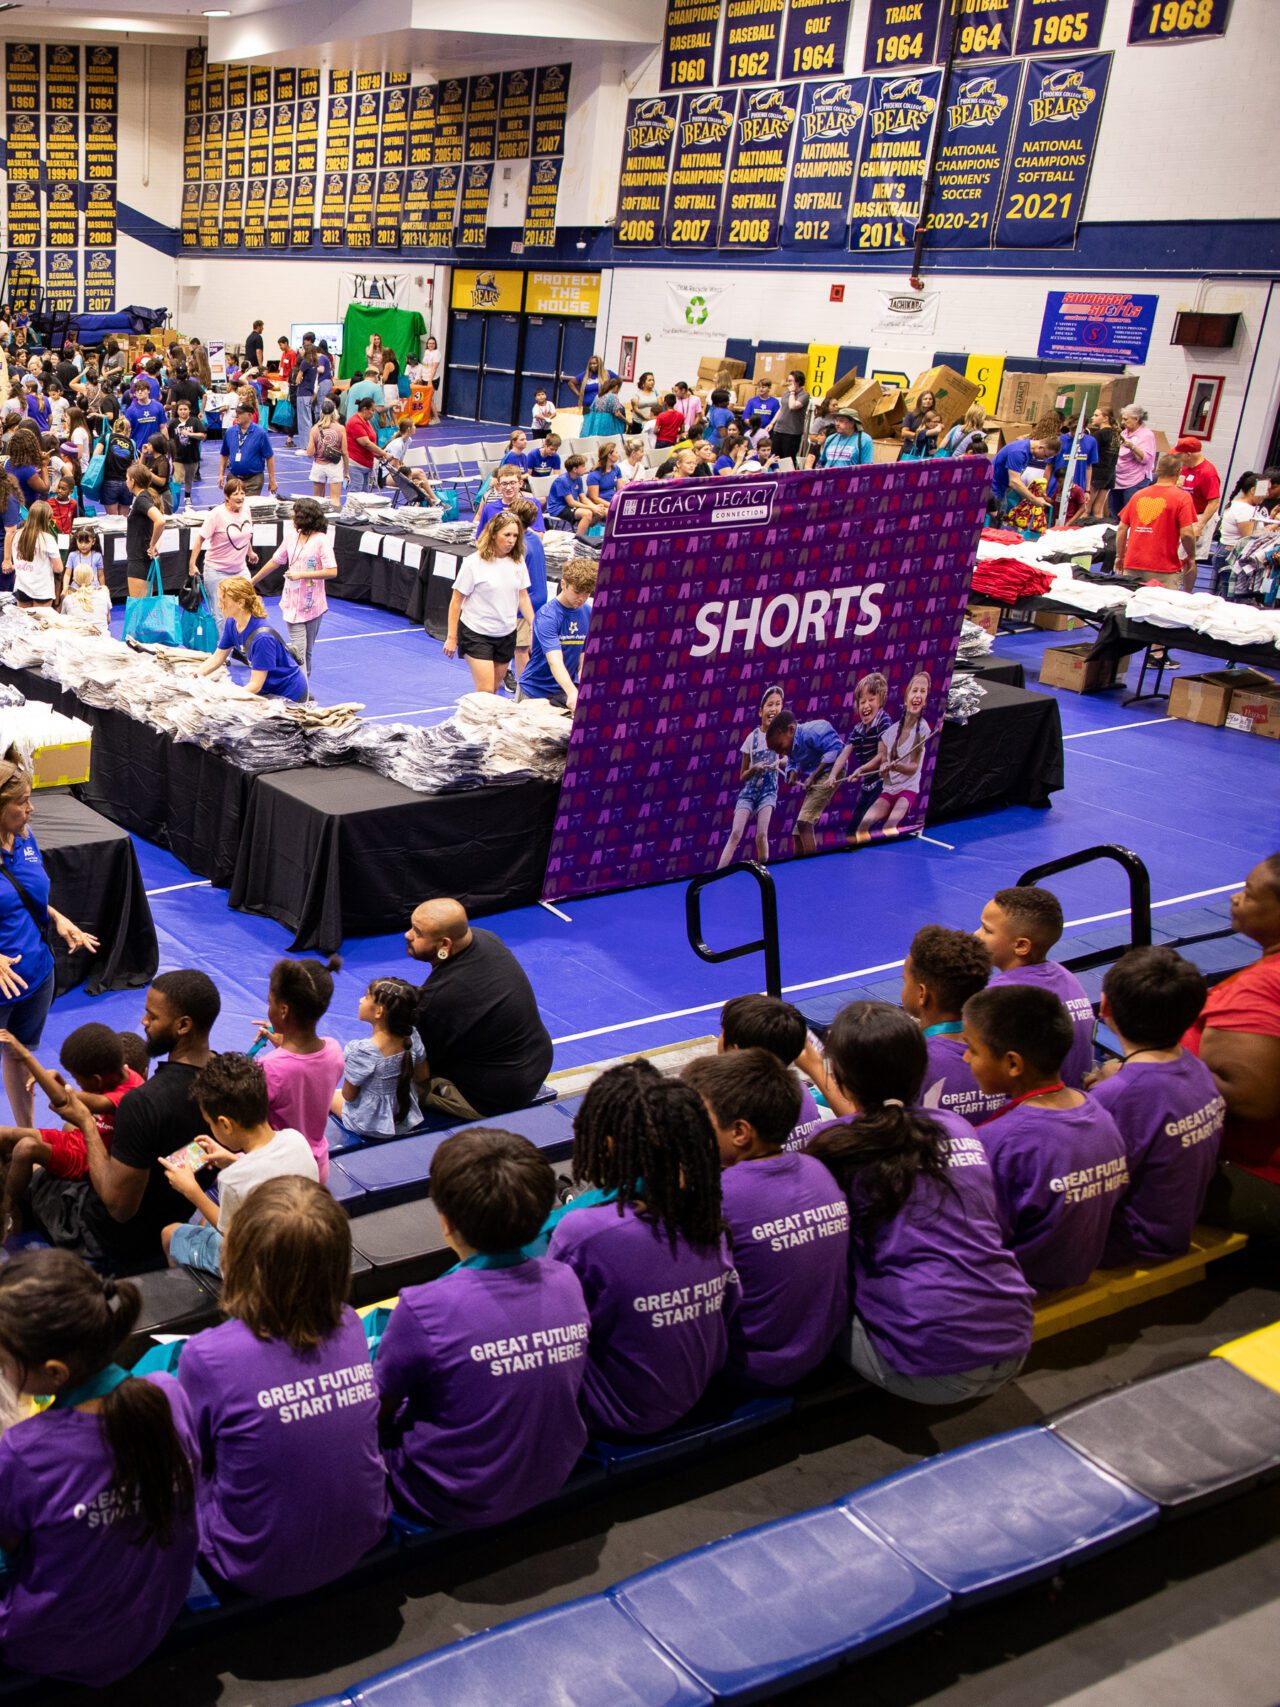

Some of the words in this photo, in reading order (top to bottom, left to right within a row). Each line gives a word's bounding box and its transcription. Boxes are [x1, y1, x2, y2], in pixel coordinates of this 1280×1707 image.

[668, 5, 720, 26] CHAMPIONS
[728, 0, 784, 18] CHAMPIONS
[886, 4, 922, 25] TRACK
[1149, 0, 1213, 33] 1968
[729, 24, 775, 44] BASEBALL
[805, 16, 831, 35] GOLF
[1032, 13, 1089, 46] 1965
[670, 32, 711, 51] BASEBALL
[954, 23, 1002, 54] 964
[876, 33, 923, 63] 1964
[729, 52, 770, 78] 1962
[793, 44, 835, 72] 1964
[670, 58, 705, 84] 1960
[11, 97, 35, 108] 1960
[90, 98, 113, 110] 1964
[948, 104, 1001, 131] BEARS
[1029, 98, 1088, 126] BEARS
[740, 118, 789, 145] BEARS
[803, 112, 857, 140] BEARS
[870, 110, 929, 137] BEARS
[536, 135, 560, 152] 2007
[628, 127, 671, 150] BEARS
[681, 123, 728, 147] BEARS
[469, 142, 491, 157] 2006
[498, 141, 529, 158] 2006-07
[801, 142, 850, 160] NATIONAL
[870, 141, 921, 158] NATIONAL
[942, 144, 997, 157] NATIONAL
[1022, 139, 1083, 152] NATIONAL
[411, 148, 431, 163] 2005
[626, 156, 665, 170] NATIONAL
[680, 153, 722, 168] NATIONAL
[738, 150, 783, 166] NATIONAL
[1014, 155, 1086, 168] CHAMPIONS
[9, 168, 39, 180] 1999-00
[89, 166, 113, 177] 2000
[794, 160, 853, 178] CHAMPIONS
[860, 160, 926, 177] CHAMPIONS
[935, 158, 1000, 172] CHAMPIONS
[622, 172, 669, 187] CHAMPIONS
[673, 169, 725, 185] CHAMPIONS
[730, 167, 787, 184] CHAMPIONS
[939, 173, 990, 186] WOMEN'S
[1017, 171, 1075, 183] SOFTBALL
[872, 183, 906, 199] MEN'S
[942, 189, 982, 200] SOCCER
[622, 196, 660, 210] SOFTBALL
[674, 195, 716, 209] SOFTBALL
[731, 194, 777, 209] SOFTBALL
[794, 192, 842, 210] SOFTBALL
[853, 201, 920, 218] BASKETBALL
[1005, 193, 1073, 219] 2021
[926, 212, 989, 229] 2020-21
[13, 233, 36, 245] 2007
[51, 233, 74, 244] 2008
[89, 232, 112, 243] 2008
[377, 230, 396, 243] 2013
[462, 228, 485, 243] 2015
[525, 229, 555, 246] 2014-15
[619, 220, 655, 241] 2006
[671, 219, 710, 242] 2007
[729, 219, 770, 242] 2008
[794, 220, 830, 240] 2012
[859, 223, 907, 248] 2014
[534, 274, 600, 286] PROTECT
[471, 290, 500, 307] BEARS
[550, 286, 580, 299] THE
[88, 298, 111, 310] 2017
[537, 299, 590, 313] HOUSE
[640, 494, 707, 515] LEGACY
[714, 489, 773, 507] LEGACY
[716, 509, 764, 519] CONNECTION
[689, 583, 886, 658] SHORTS
[942, 1091, 977, 1105] GREAT
[953, 1102, 984, 1115] START
[1165, 1109, 1206, 1137] GREAT
[1181, 1121, 1213, 1148] START
[1049, 1167, 1095, 1192] GREAT
[1064, 1181, 1103, 1204] START
[751, 1213, 801, 1240] GREAT
[803, 1201, 848, 1225] FUTURE
[770, 1227, 815, 1252] START
[633, 1287, 690, 1312] GREAT
[651, 1302, 702, 1328] START
[470, 1335, 528, 1362] GREAT
[490, 1351, 544, 1376] START
[547, 1342, 583, 1364] HERE.
[257, 1378, 315, 1409] GREAT
[318, 1362, 374, 1392] FUTURE
[279, 1394, 332, 1423] START
[336, 1382, 376, 1408] HERE.
